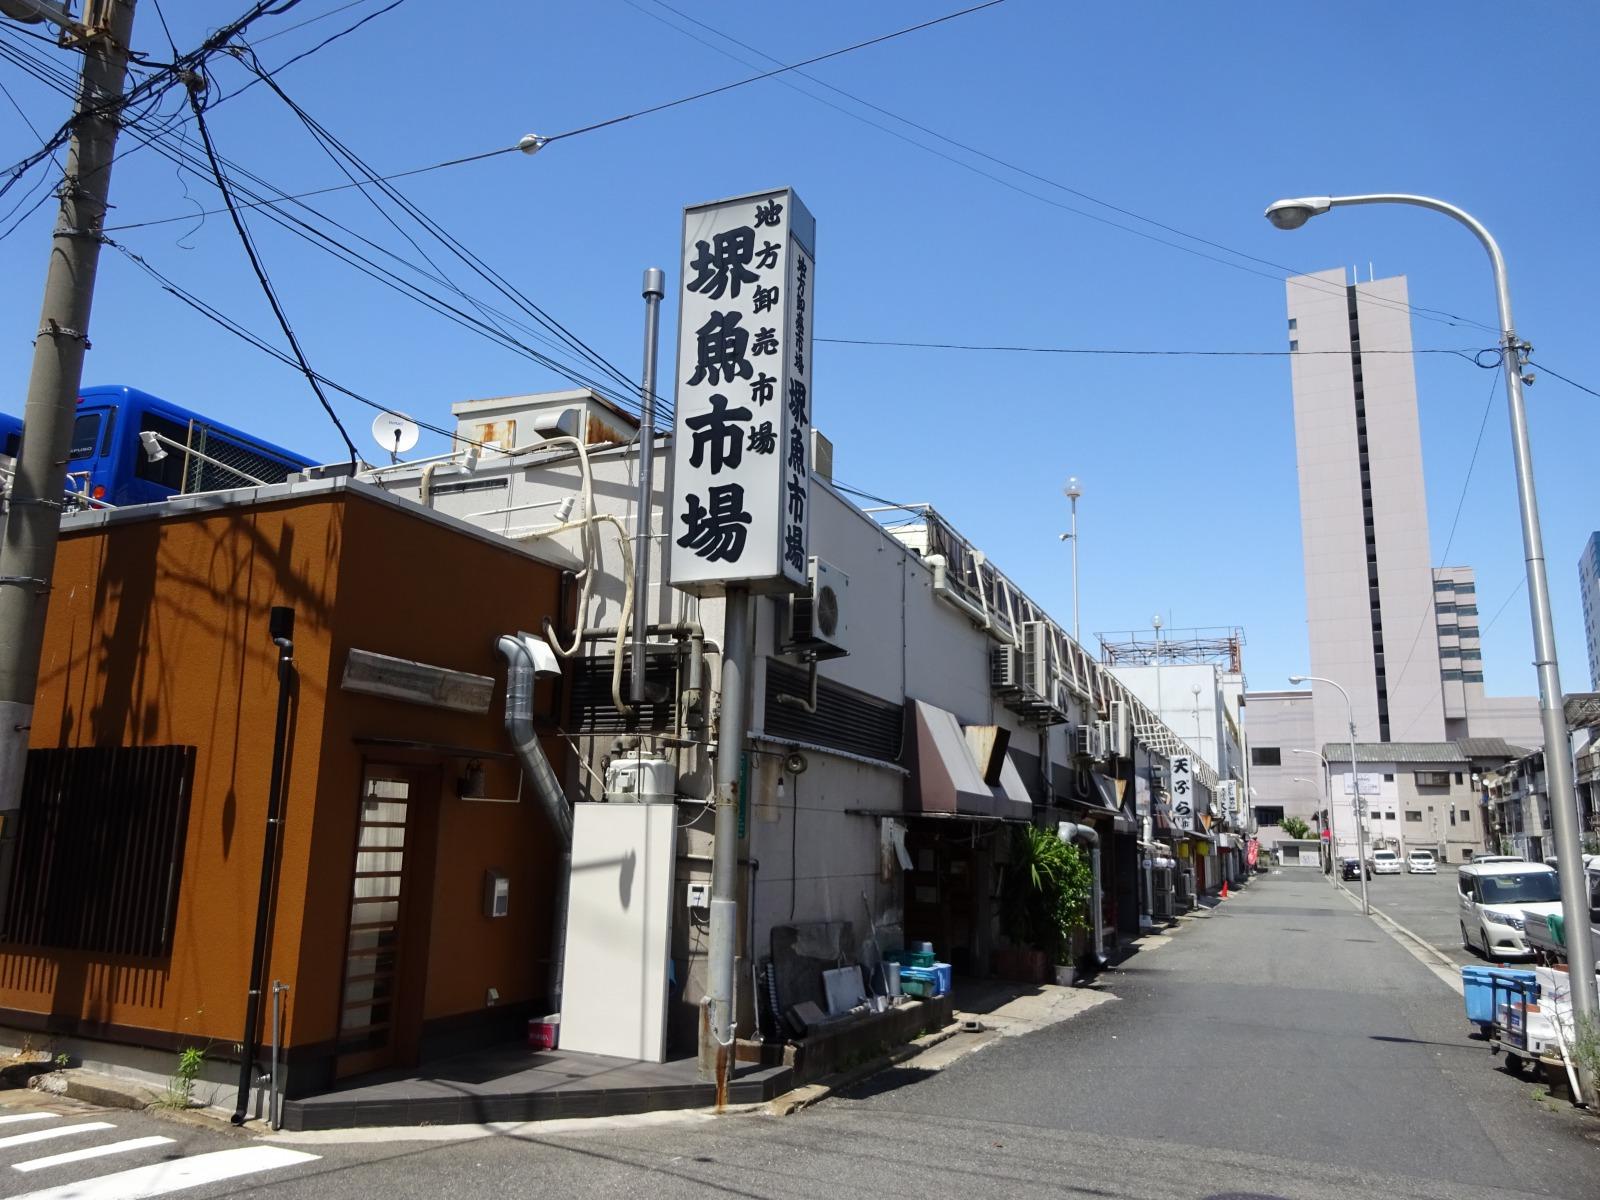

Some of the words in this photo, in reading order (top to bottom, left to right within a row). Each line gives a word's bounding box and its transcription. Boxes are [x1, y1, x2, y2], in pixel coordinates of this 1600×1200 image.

[676, 225, 760, 563] 堺魚市場
[746, 199, 783, 455] 地方卸売市場
[784, 377, 808, 574] 堺魚市場
[1173, 758, 1190, 815] 天ぷら
